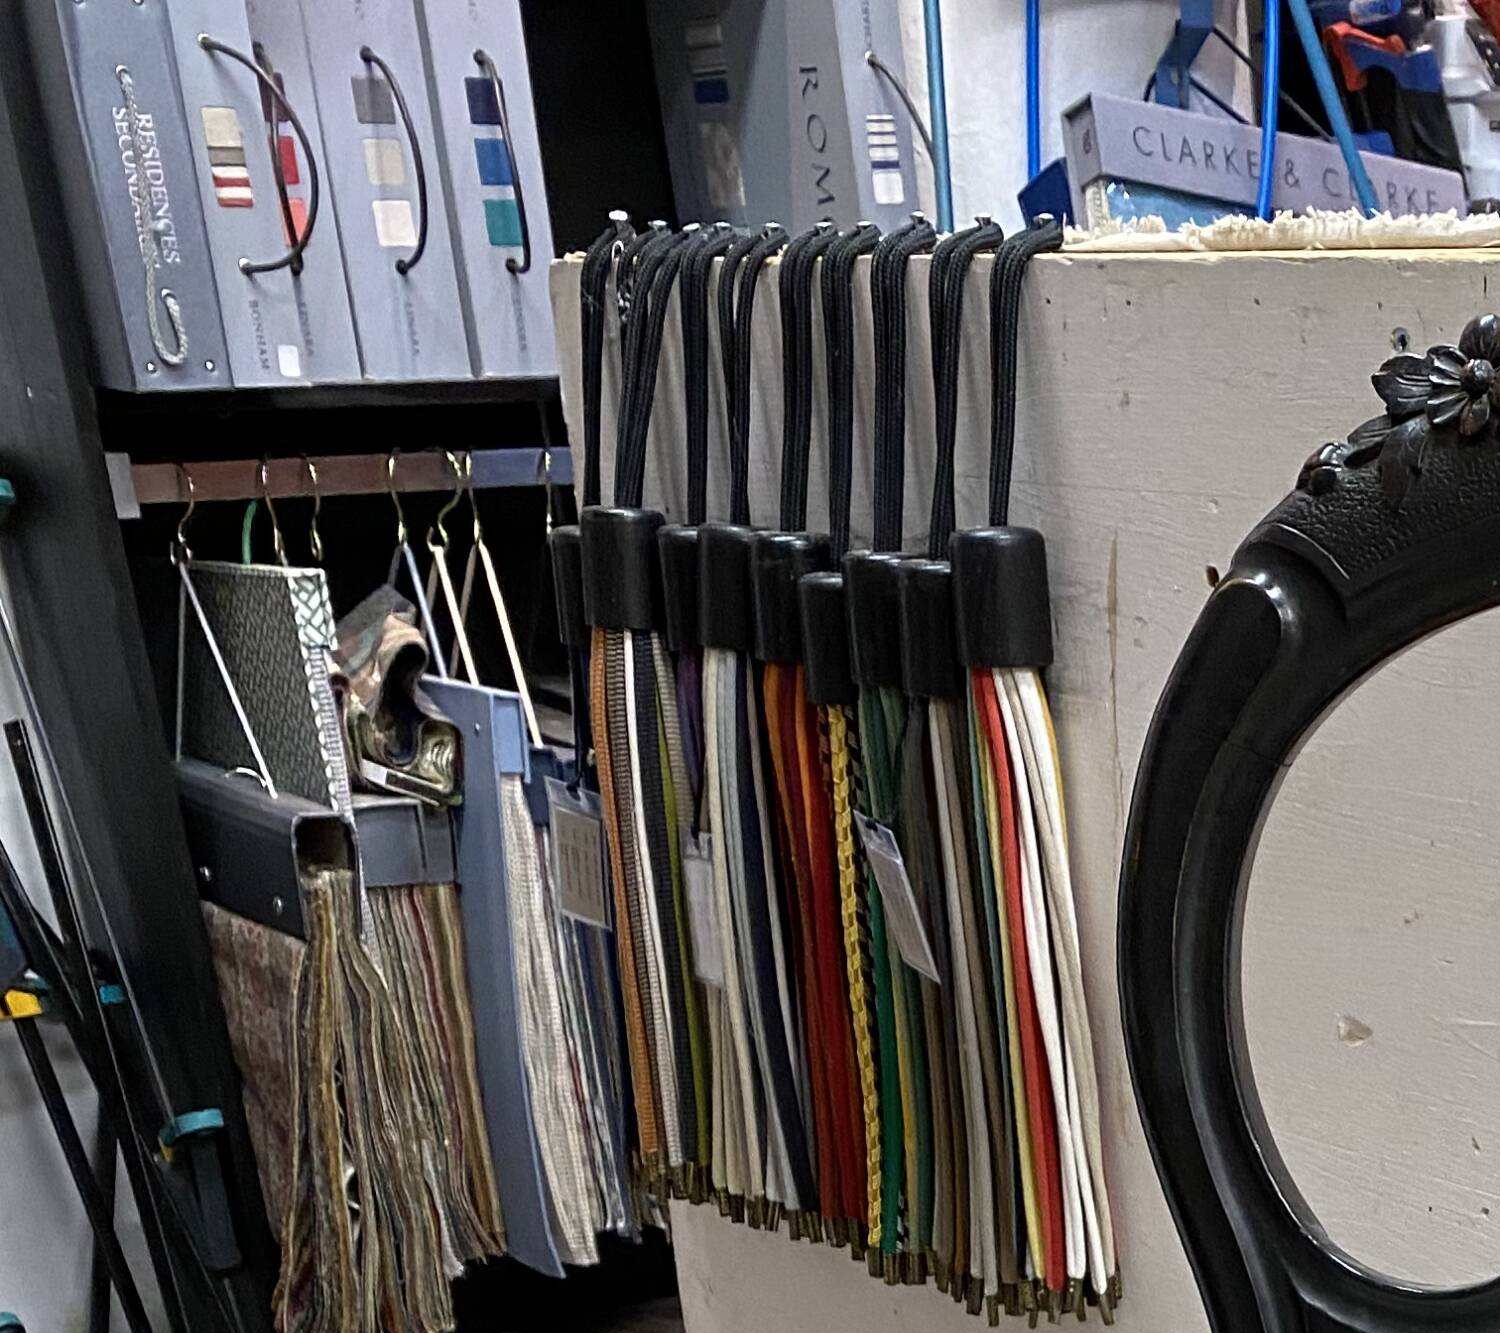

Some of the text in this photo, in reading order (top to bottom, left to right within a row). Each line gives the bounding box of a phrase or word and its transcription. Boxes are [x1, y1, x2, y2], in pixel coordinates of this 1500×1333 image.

[136, 112, 181, 264] RESIDENCES
[799, 65, 836, 223] ROM
[1132, 125, 1262, 179] CLARKE
[1284, 159, 1301, 189] &
[1321, 167, 1439, 216] CLRKE
